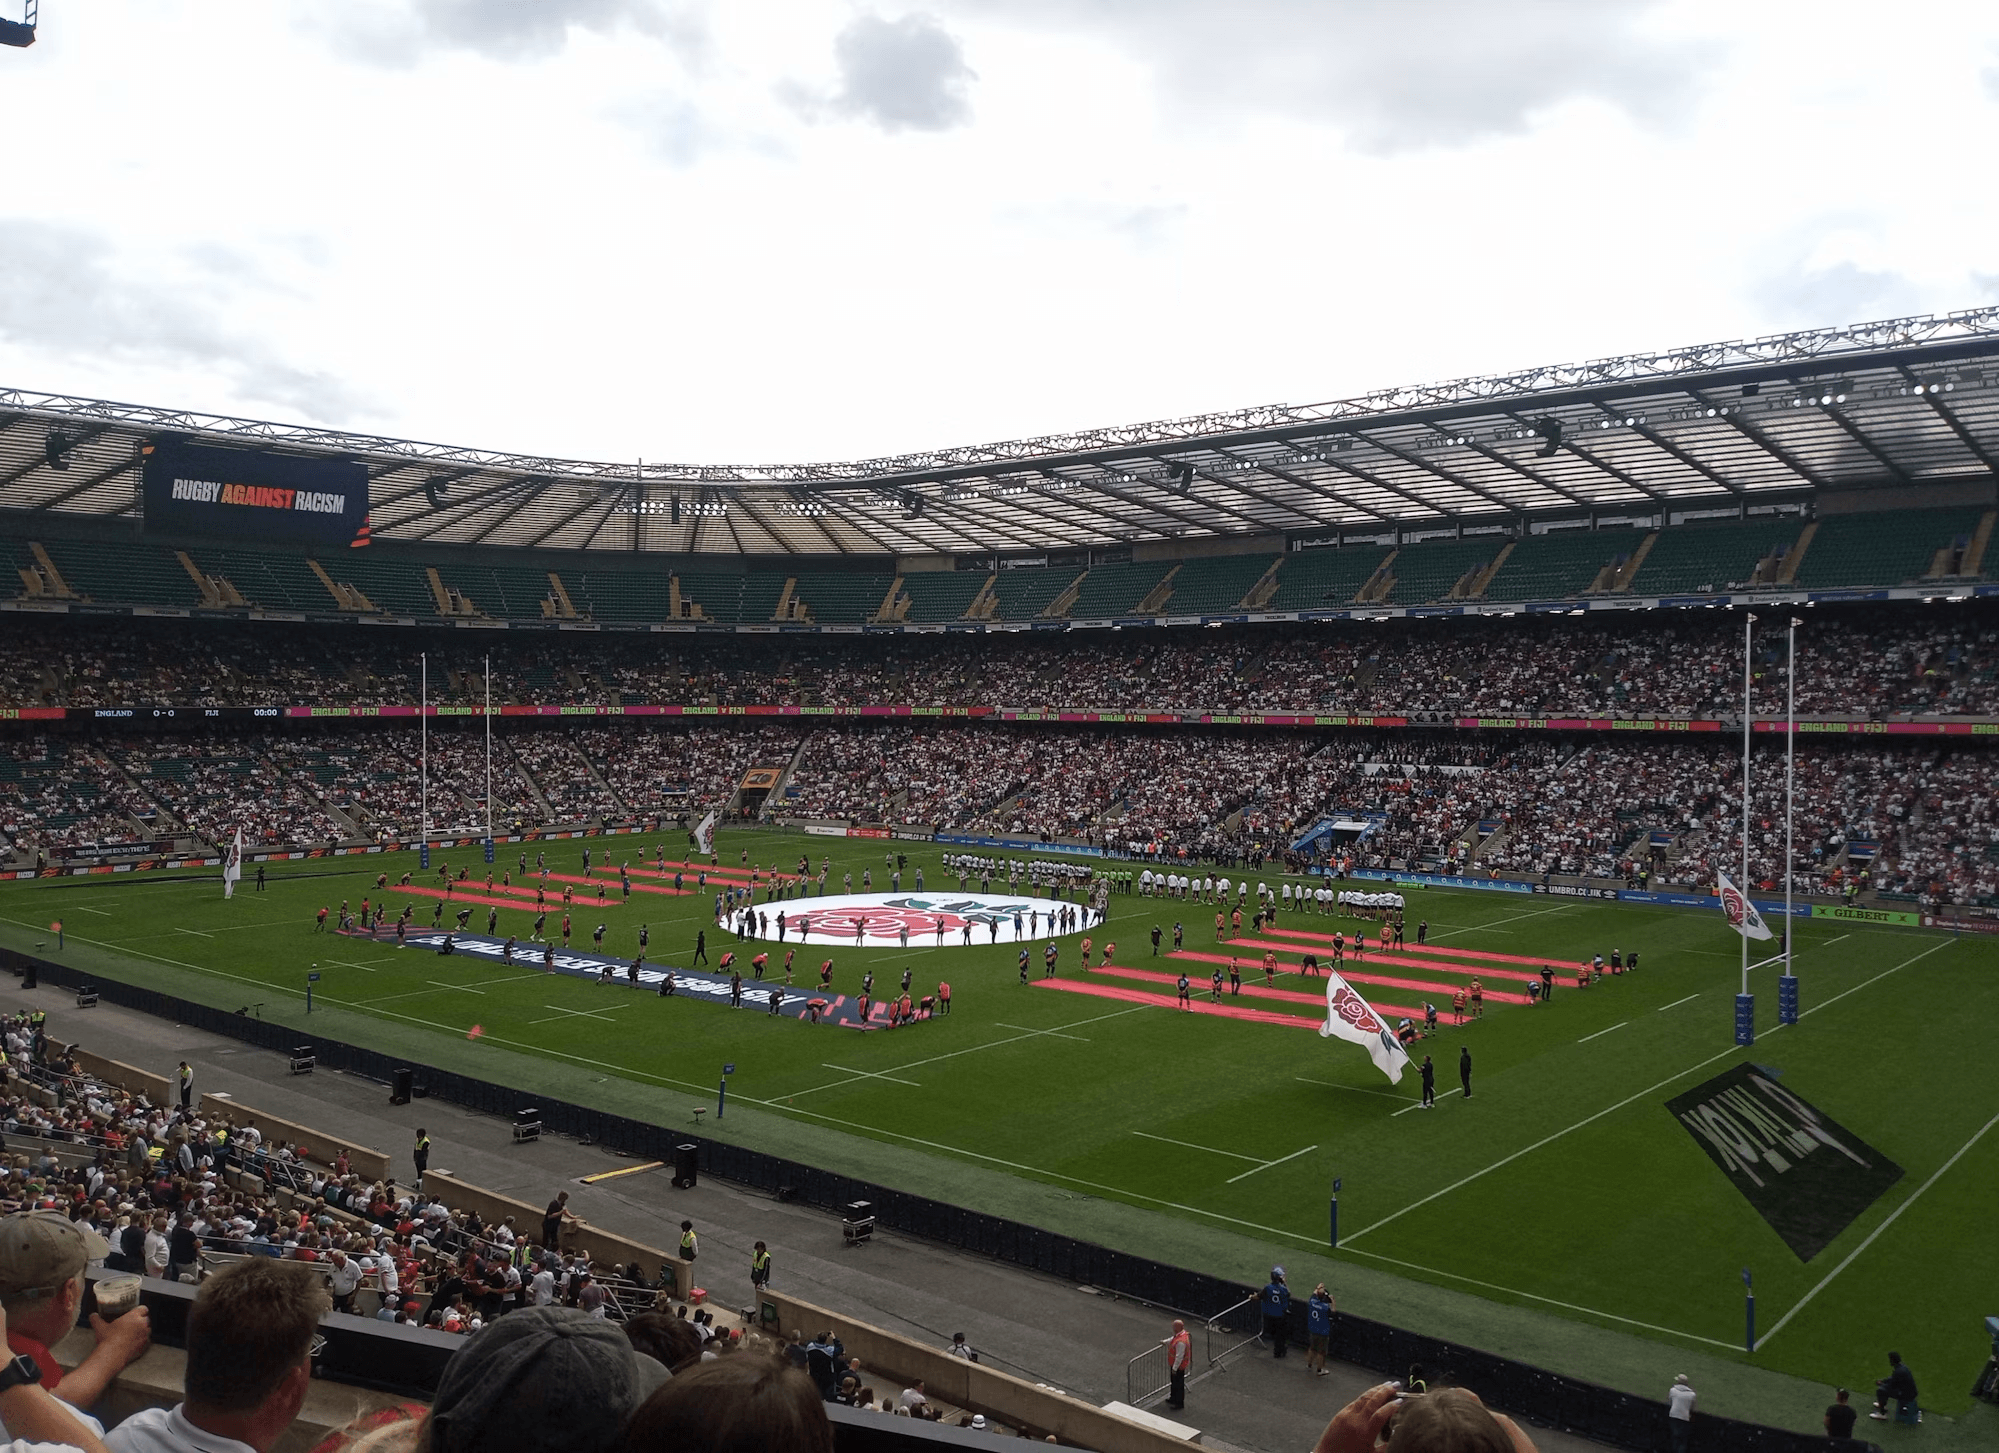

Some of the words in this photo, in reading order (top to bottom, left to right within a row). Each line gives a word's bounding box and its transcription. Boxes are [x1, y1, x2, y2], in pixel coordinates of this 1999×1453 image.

[172, 478, 222, 503] RUGBY
[220, 483, 294, 510] AGAINST
[294, 490, 345, 514] RACISM
[311, 708, 350, 716] ENGLAND
[362, 708, 379, 716] FIJI
[1358, 717, 1373, 725] FIJI
[1612, 721, 1655, 729] ENGLAND
[1669, 722, 1689, 730] FIJI
[1799, 723, 1848, 732] ENGLAND
[1864, 724, 1888, 733] FIJI
[1834, 908, 1890, 922] GILBERT
